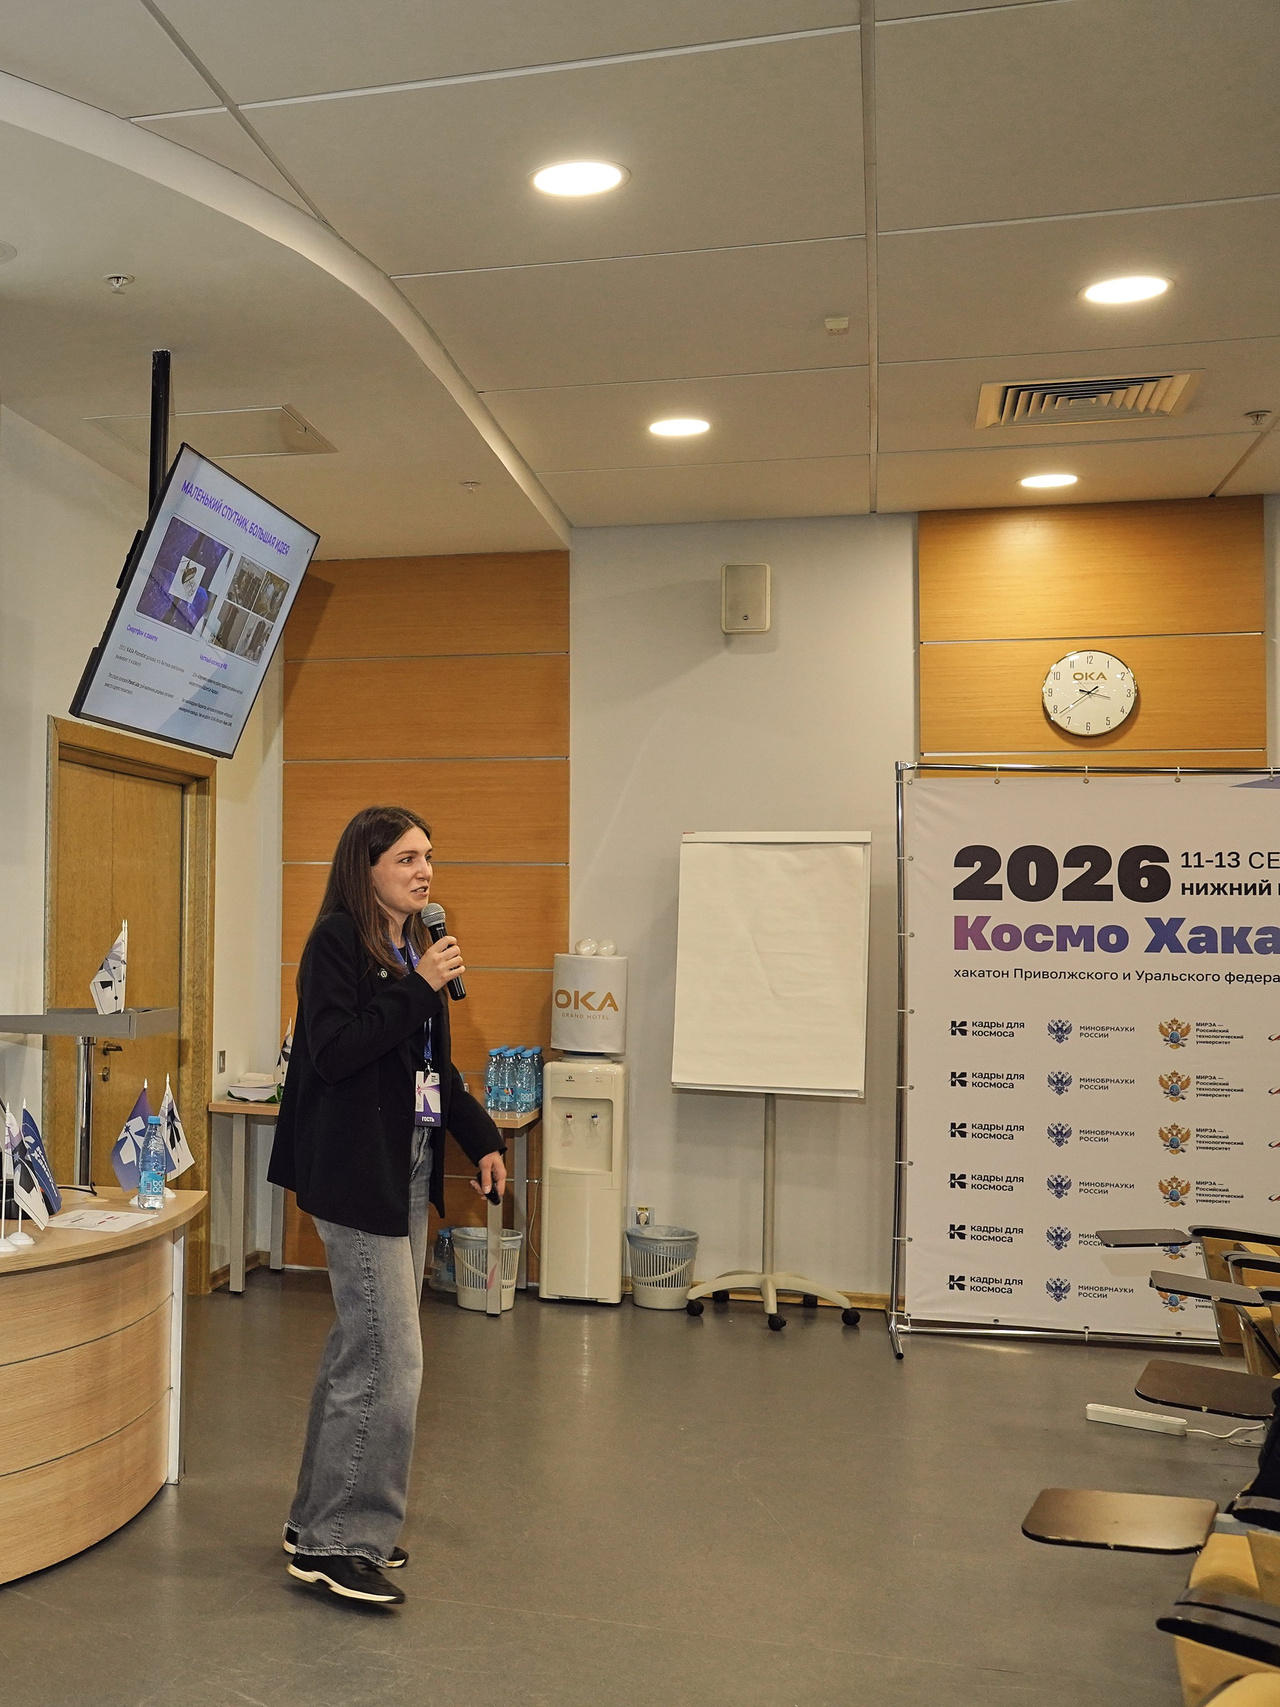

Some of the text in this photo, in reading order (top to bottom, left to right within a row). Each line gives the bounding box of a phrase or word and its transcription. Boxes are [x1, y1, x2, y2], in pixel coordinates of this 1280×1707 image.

[181, 480, 291, 556] МАЛЕНЬКИЙ СПУТНИК, БОЛЬШАЯ ИДЕЯ
[1070, 660, 1075, 668] 11
[1086, 656, 1094, 664] 12
[1053, 672, 1061, 680] 10
[1073, 672, 1108, 681] OKA
[1121, 672, 1126, 681] 2
[1048, 688, 1053, 697] 9
[1126, 689, 1131, 698] 3
[1053, 705, 1058, 714] 8
[1120, 706, 1125, 714] 4
[1067, 717, 1072, 725] 7
[1106, 717, 1110, 726] 5
[1086, 722, 1090, 731] 6
[1181, 851, 1241, 868] 11-13
[952, 844, 1172, 903] 2026
[1181, 879, 1272, 896] нижний
[954, 915, 1129, 954] Космо
[954, 969, 1009, 978] хакатон
[1013, 968, 1119, 981] Приволжского
[1122, 972, 1131, 981] и
[1135, 970, 1221, 984] Уральского
[555, 989, 619, 1011] OKA
[972, 1021, 1004, 1029] кадры
[972, 1072, 1004, 1080] кадры
[972, 1081, 1014, 1089] космоса
[972, 1123, 1024, 1132] кадры для
[972, 1132, 1014, 1140] космоса
[971, 1174, 1003, 1183] кадры
[970, 1225, 1002, 1234] кадры
[970, 1276, 1002, 1285] кадры
[970, 1286, 1012, 1294] космоса
